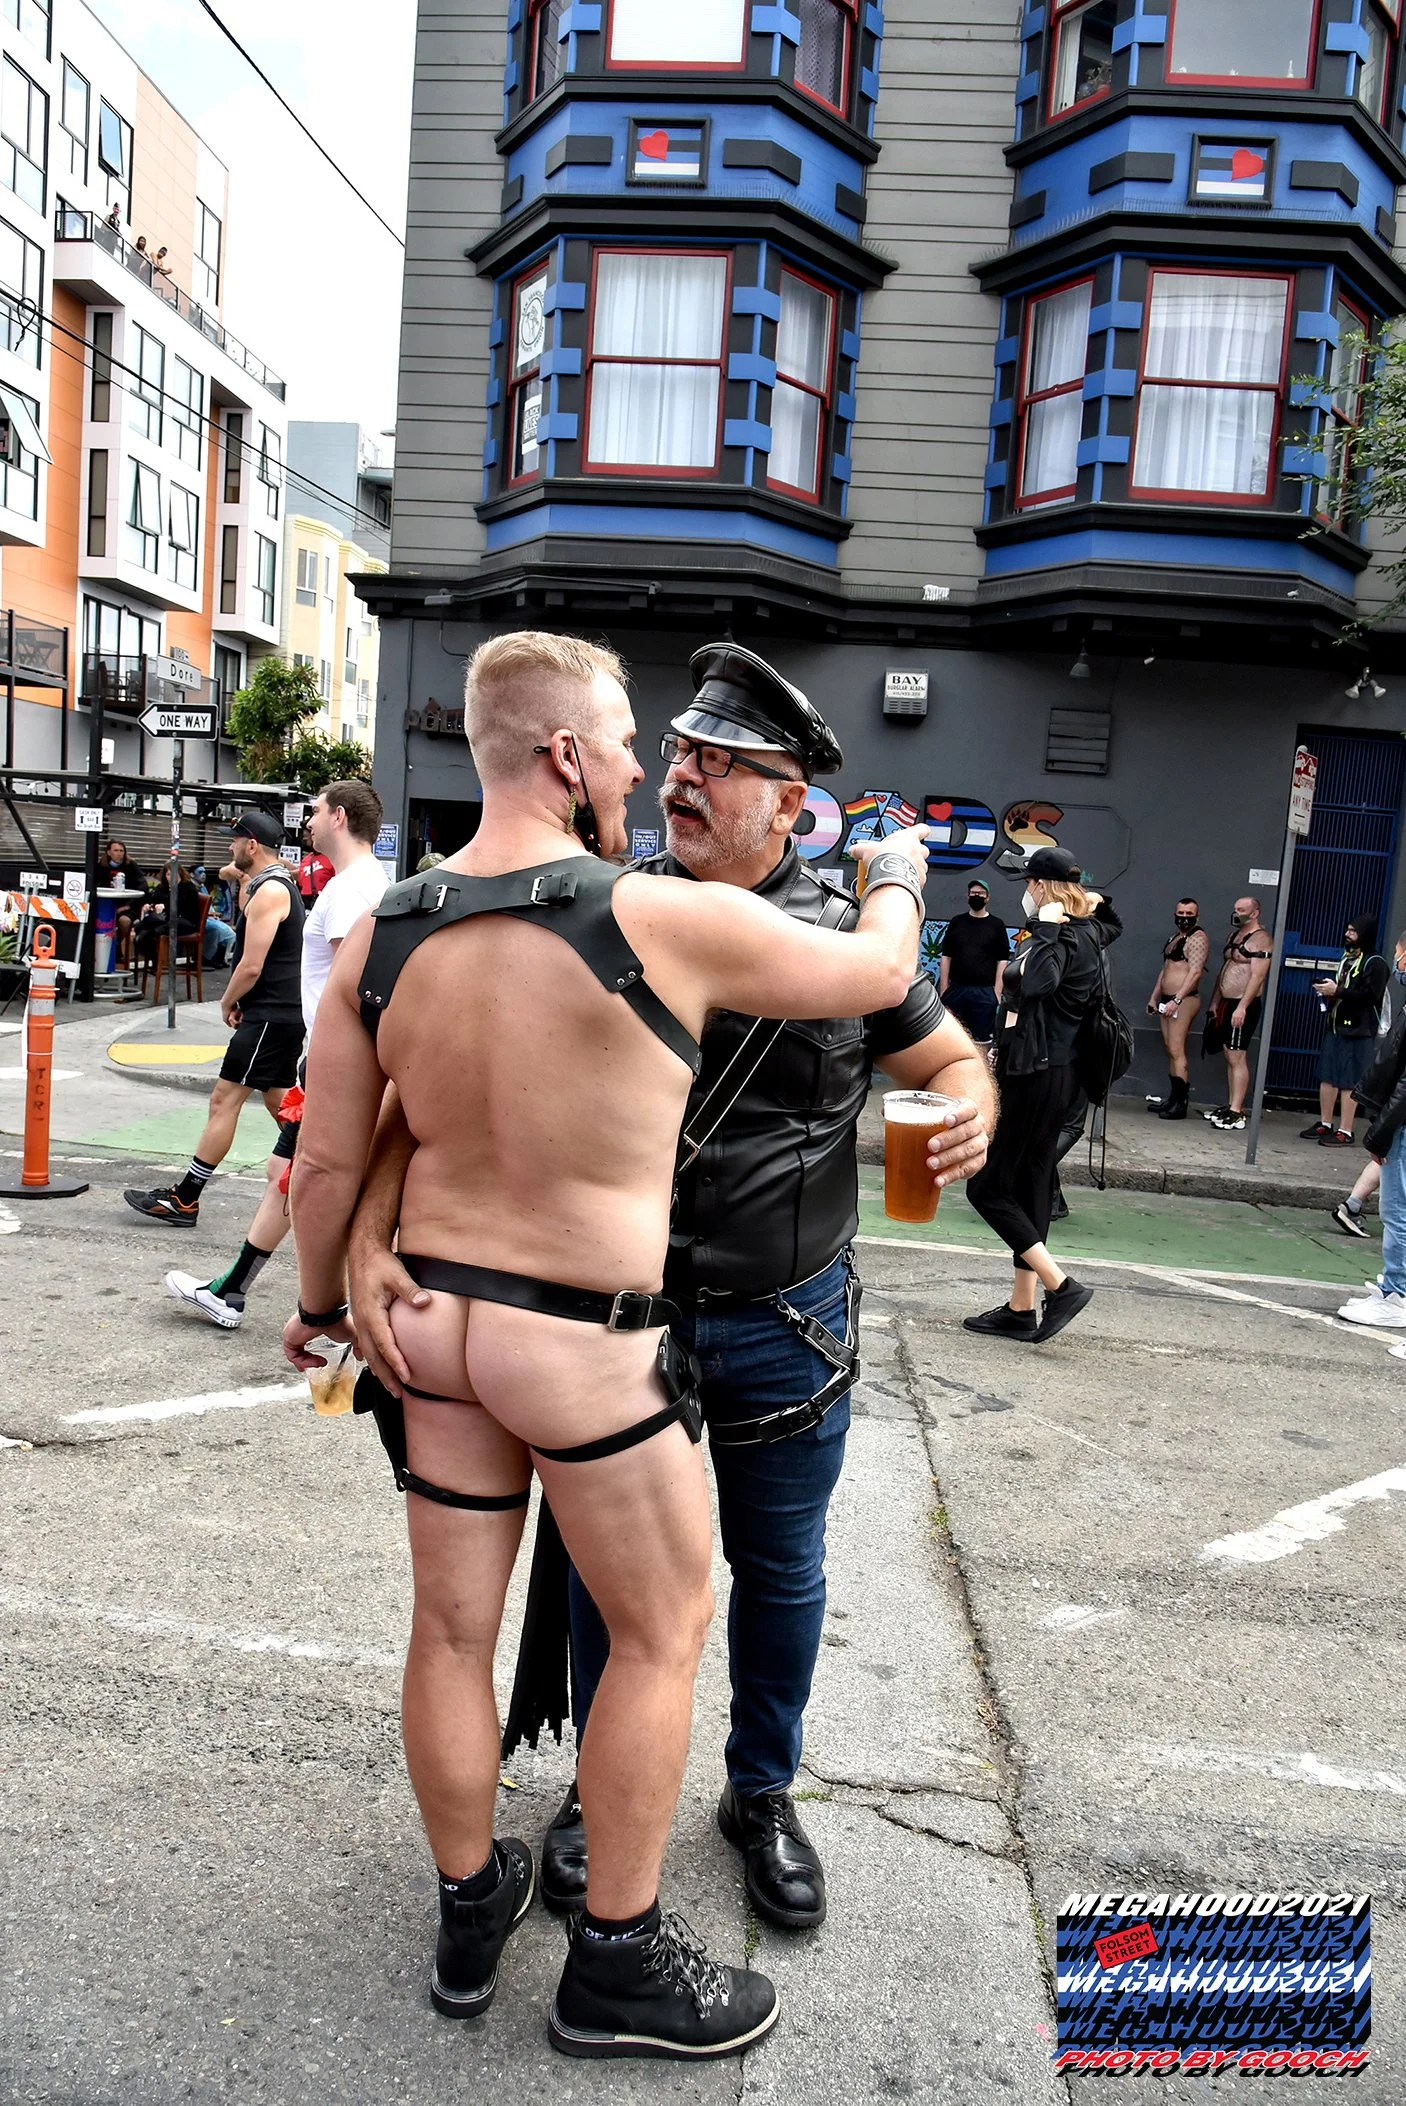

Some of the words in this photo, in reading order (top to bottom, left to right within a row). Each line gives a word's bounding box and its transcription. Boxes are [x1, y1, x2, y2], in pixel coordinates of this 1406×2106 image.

[171, 663, 193, 682] Dore
[892, 675, 922, 684] BAY
[160, 715, 180, 727] ONE
[185, 716, 208, 728] WAY
